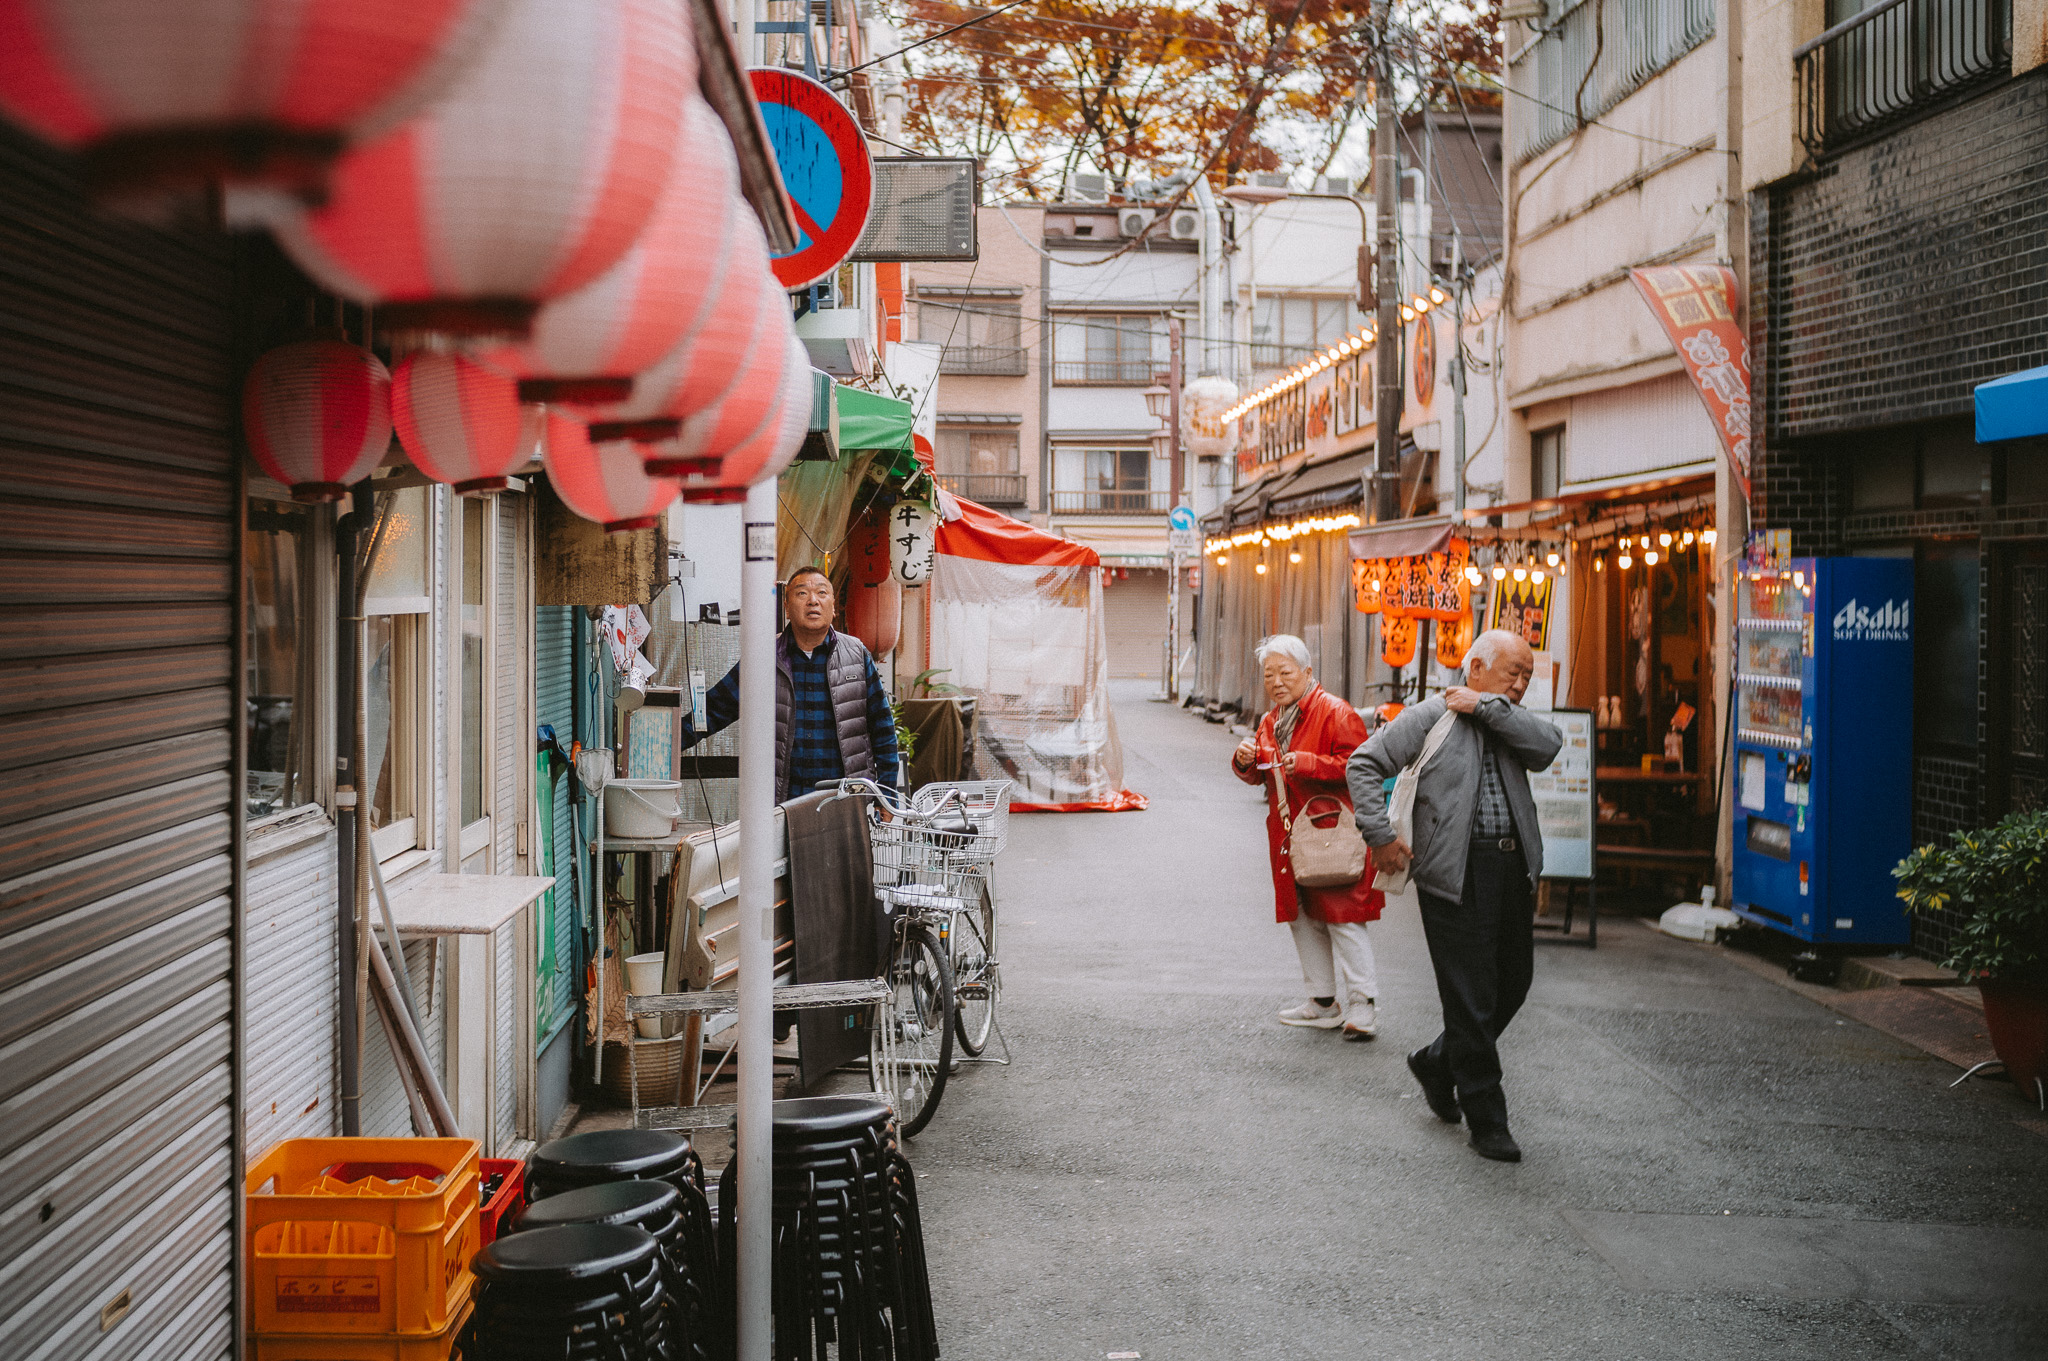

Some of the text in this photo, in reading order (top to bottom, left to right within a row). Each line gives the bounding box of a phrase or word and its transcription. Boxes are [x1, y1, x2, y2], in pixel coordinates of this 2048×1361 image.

[896, 505, 922, 581] 牛すじ
[1833, 597, 1909, 630] Asahi
[1833, 629, 1909, 641] SOFT DRINKS
[282, 1279, 375, 1294] ホッピー
